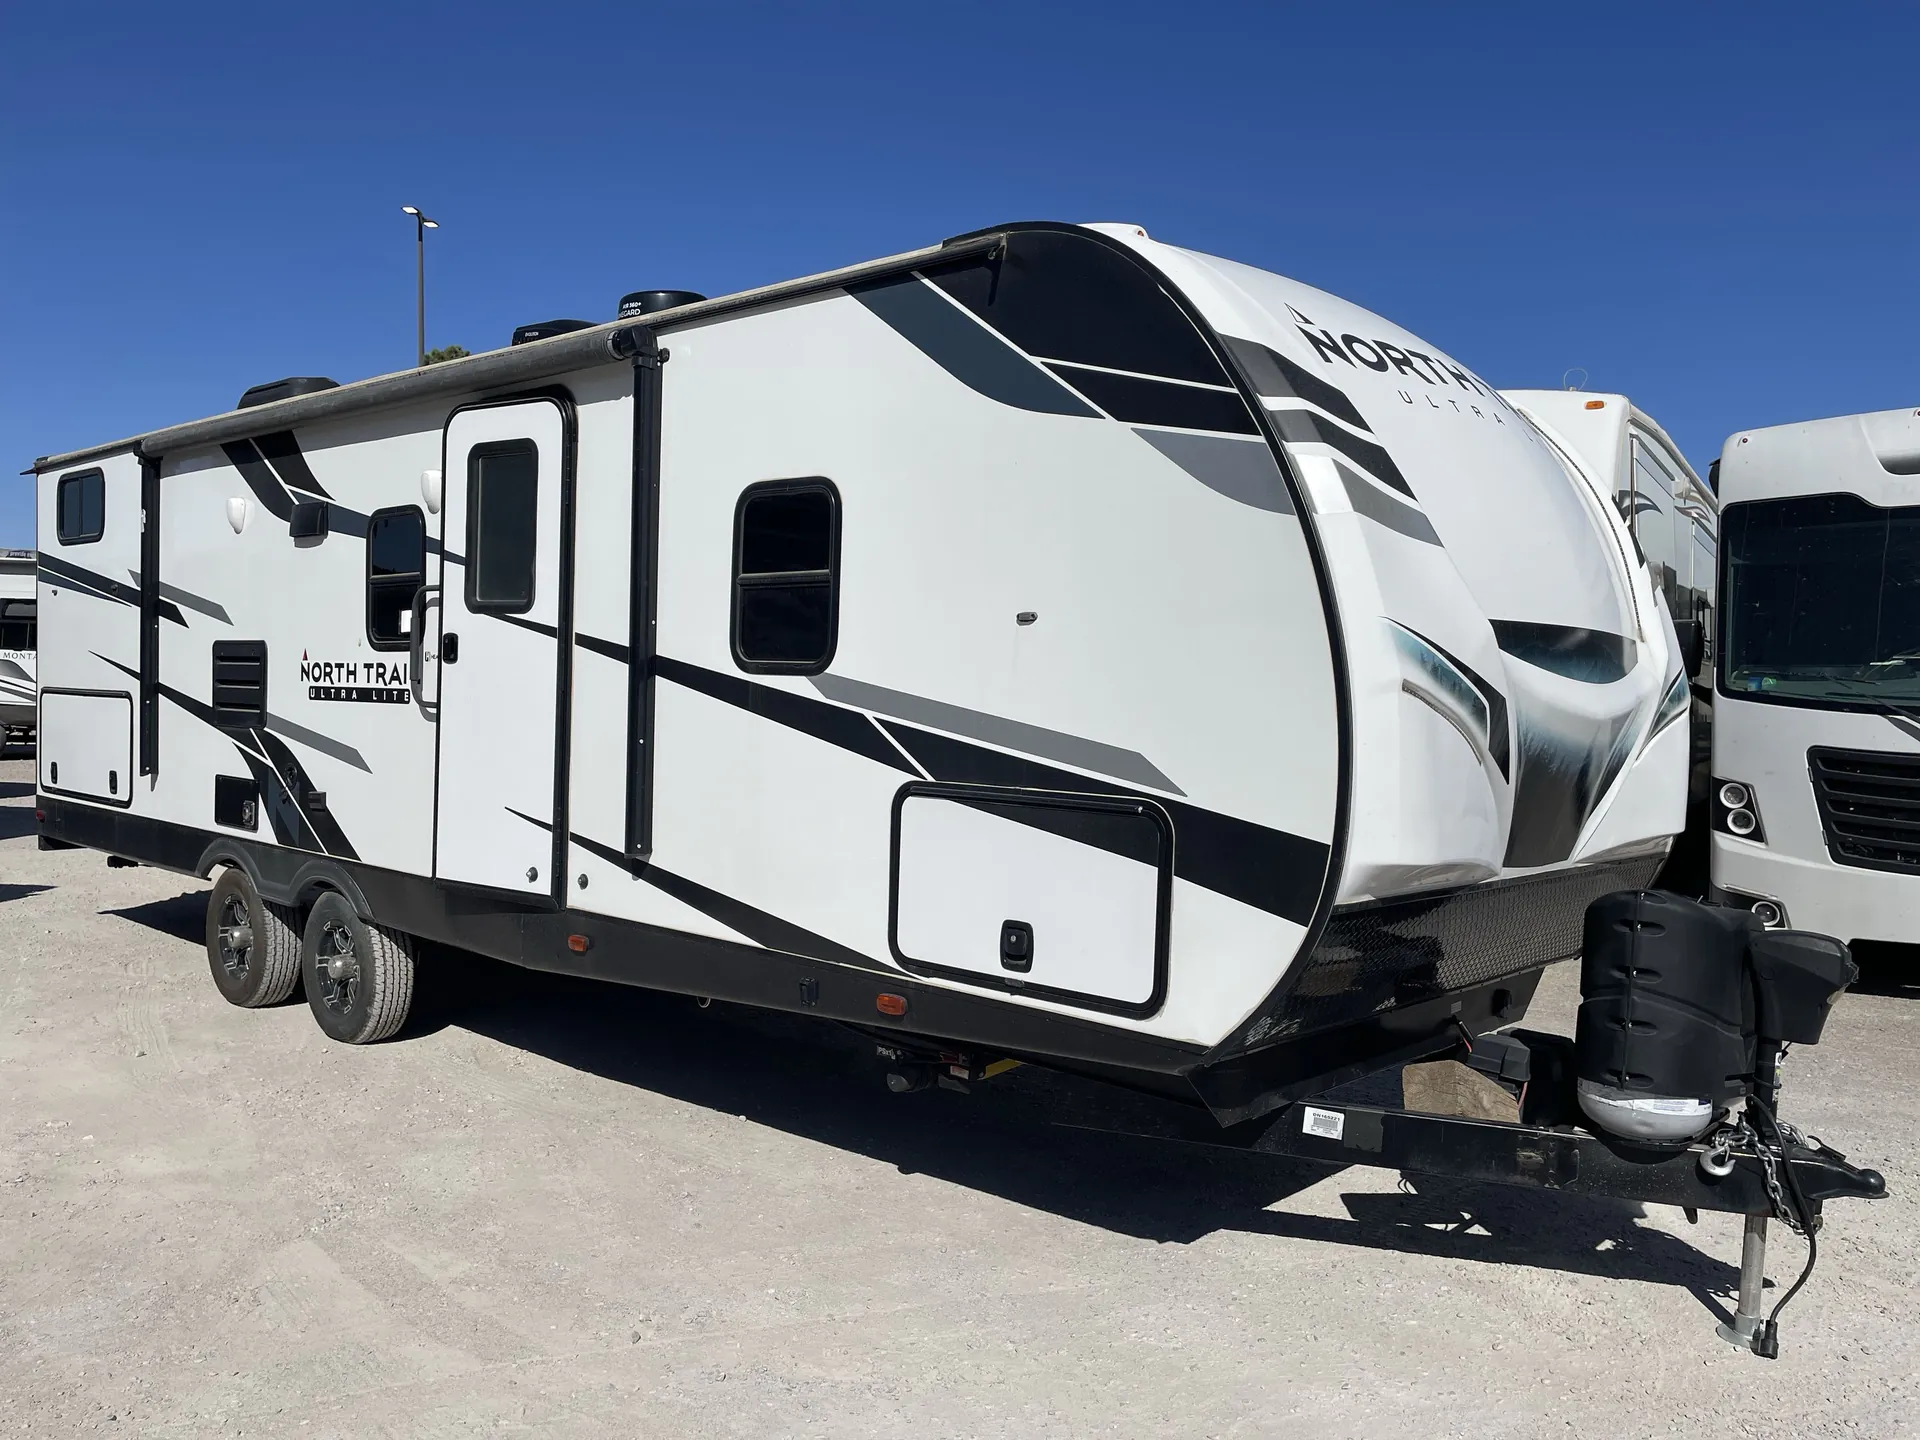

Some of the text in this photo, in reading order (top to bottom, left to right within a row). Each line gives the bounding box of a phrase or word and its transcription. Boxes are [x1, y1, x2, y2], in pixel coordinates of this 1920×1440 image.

[1294, 323, 1485, 398] NORTH
[1397, 389, 1506, 426] ULTRA
[300, 661, 409, 686] NORTH TRAI
[310, 688, 409, 702] ULTRA LITE
